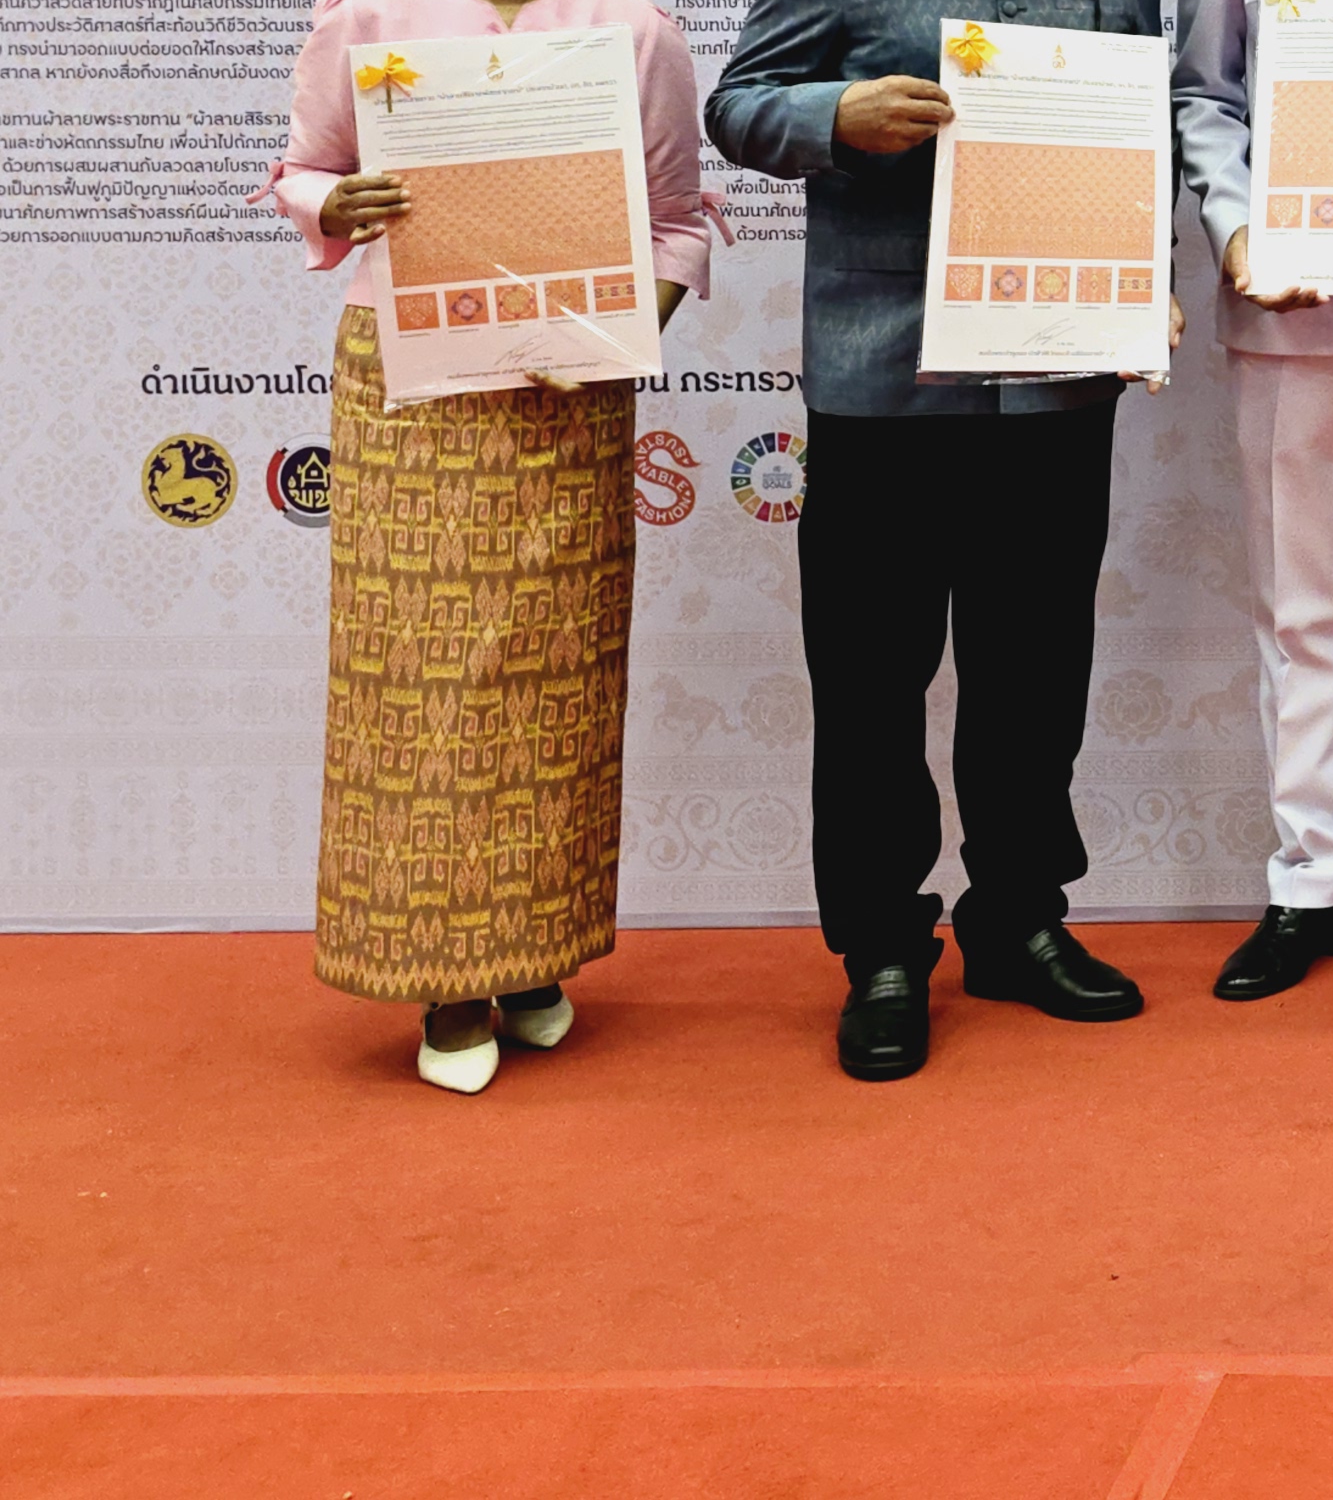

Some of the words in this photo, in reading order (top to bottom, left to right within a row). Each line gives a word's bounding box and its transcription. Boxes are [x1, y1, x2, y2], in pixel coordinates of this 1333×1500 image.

[0, 67, 42, 80] สากล
[141, 363, 334, 395] ดำเนินงานโด
